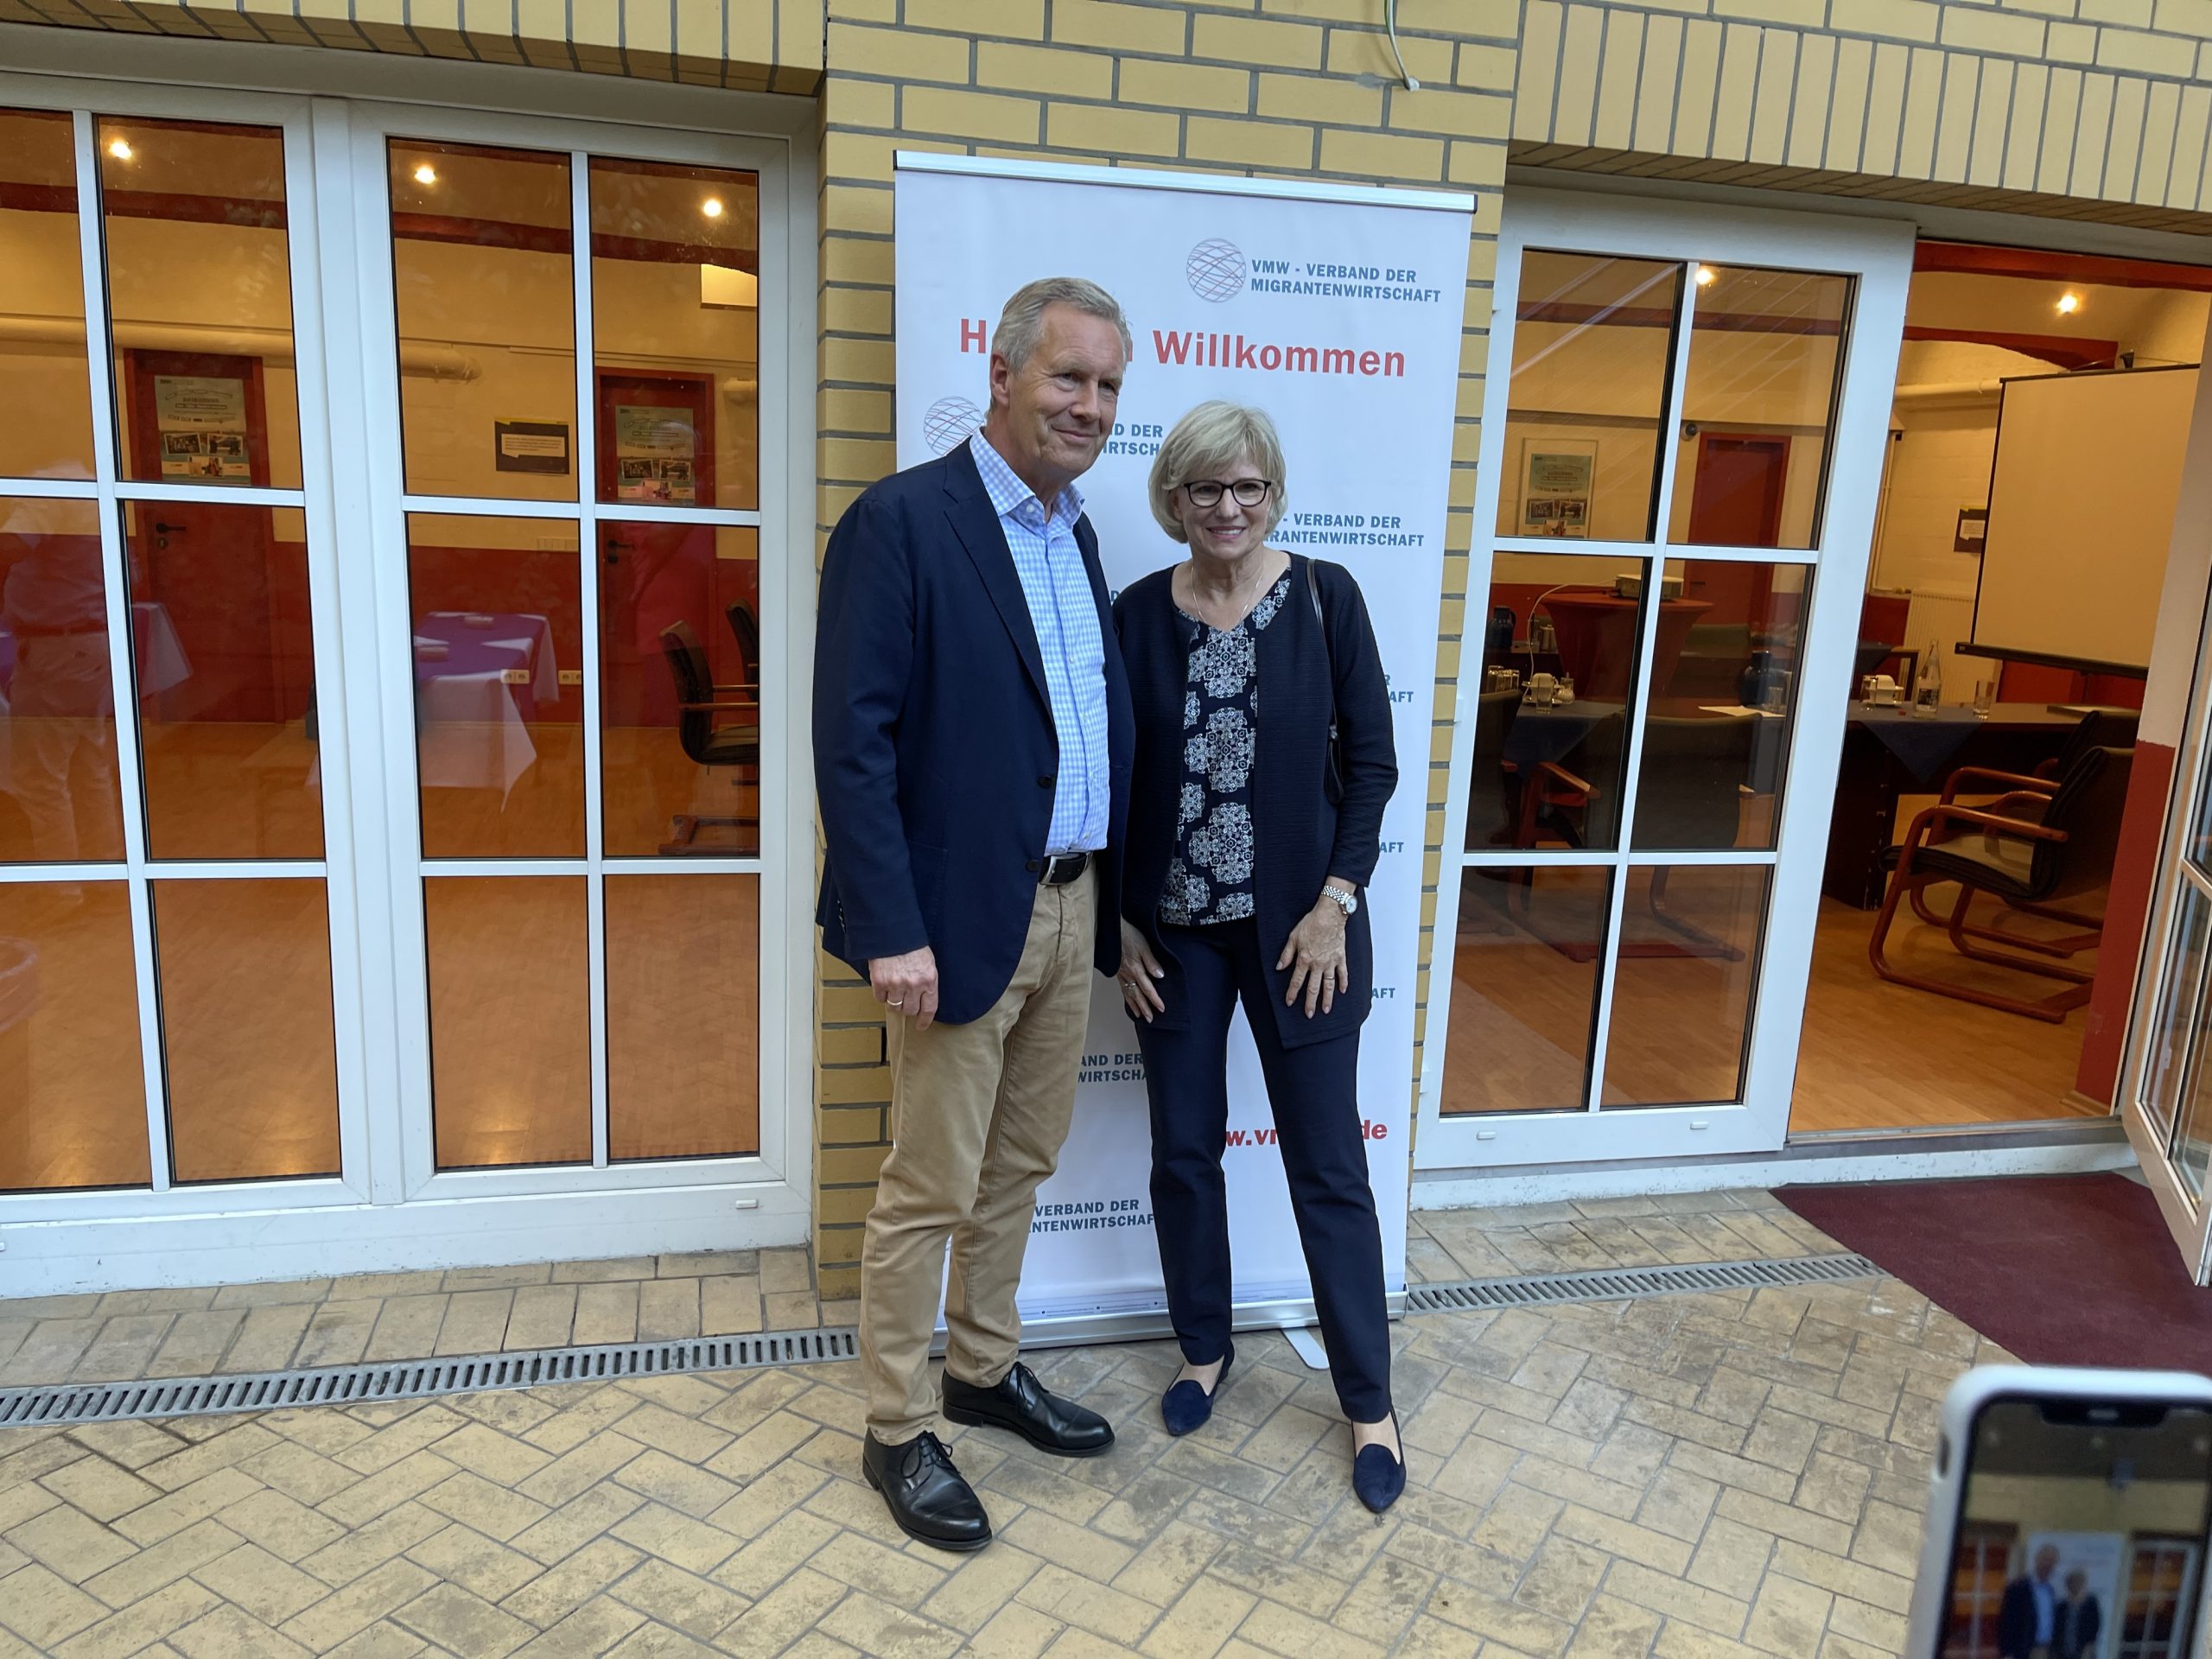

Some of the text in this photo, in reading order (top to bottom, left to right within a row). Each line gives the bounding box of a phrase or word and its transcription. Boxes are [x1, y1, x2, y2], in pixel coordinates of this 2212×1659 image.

[1251, 259, 1290, 275] VMW
[1306, 263, 1380, 280] VERBAND
[1385, 269, 1417, 283] DER
[1250, 278, 1441, 302] MIGRANTENWIRTSCHAFT
[1152, 330, 1406, 378] Willkommen
[1130, 423, 1163, 438] DER
[1294, 513, 1365, 527] VERBAND
[1370, 516, 1402, 529] DER
[1265, 530, 1425, 547] RANTENWIRTSCHAFT
[1114, 1053, 1143, 1065] DER
[1035, 1199, 1140, 1217] VERBAND DER
[1028, 1213, 1154, 1233] NTENWIRTSCHAF
